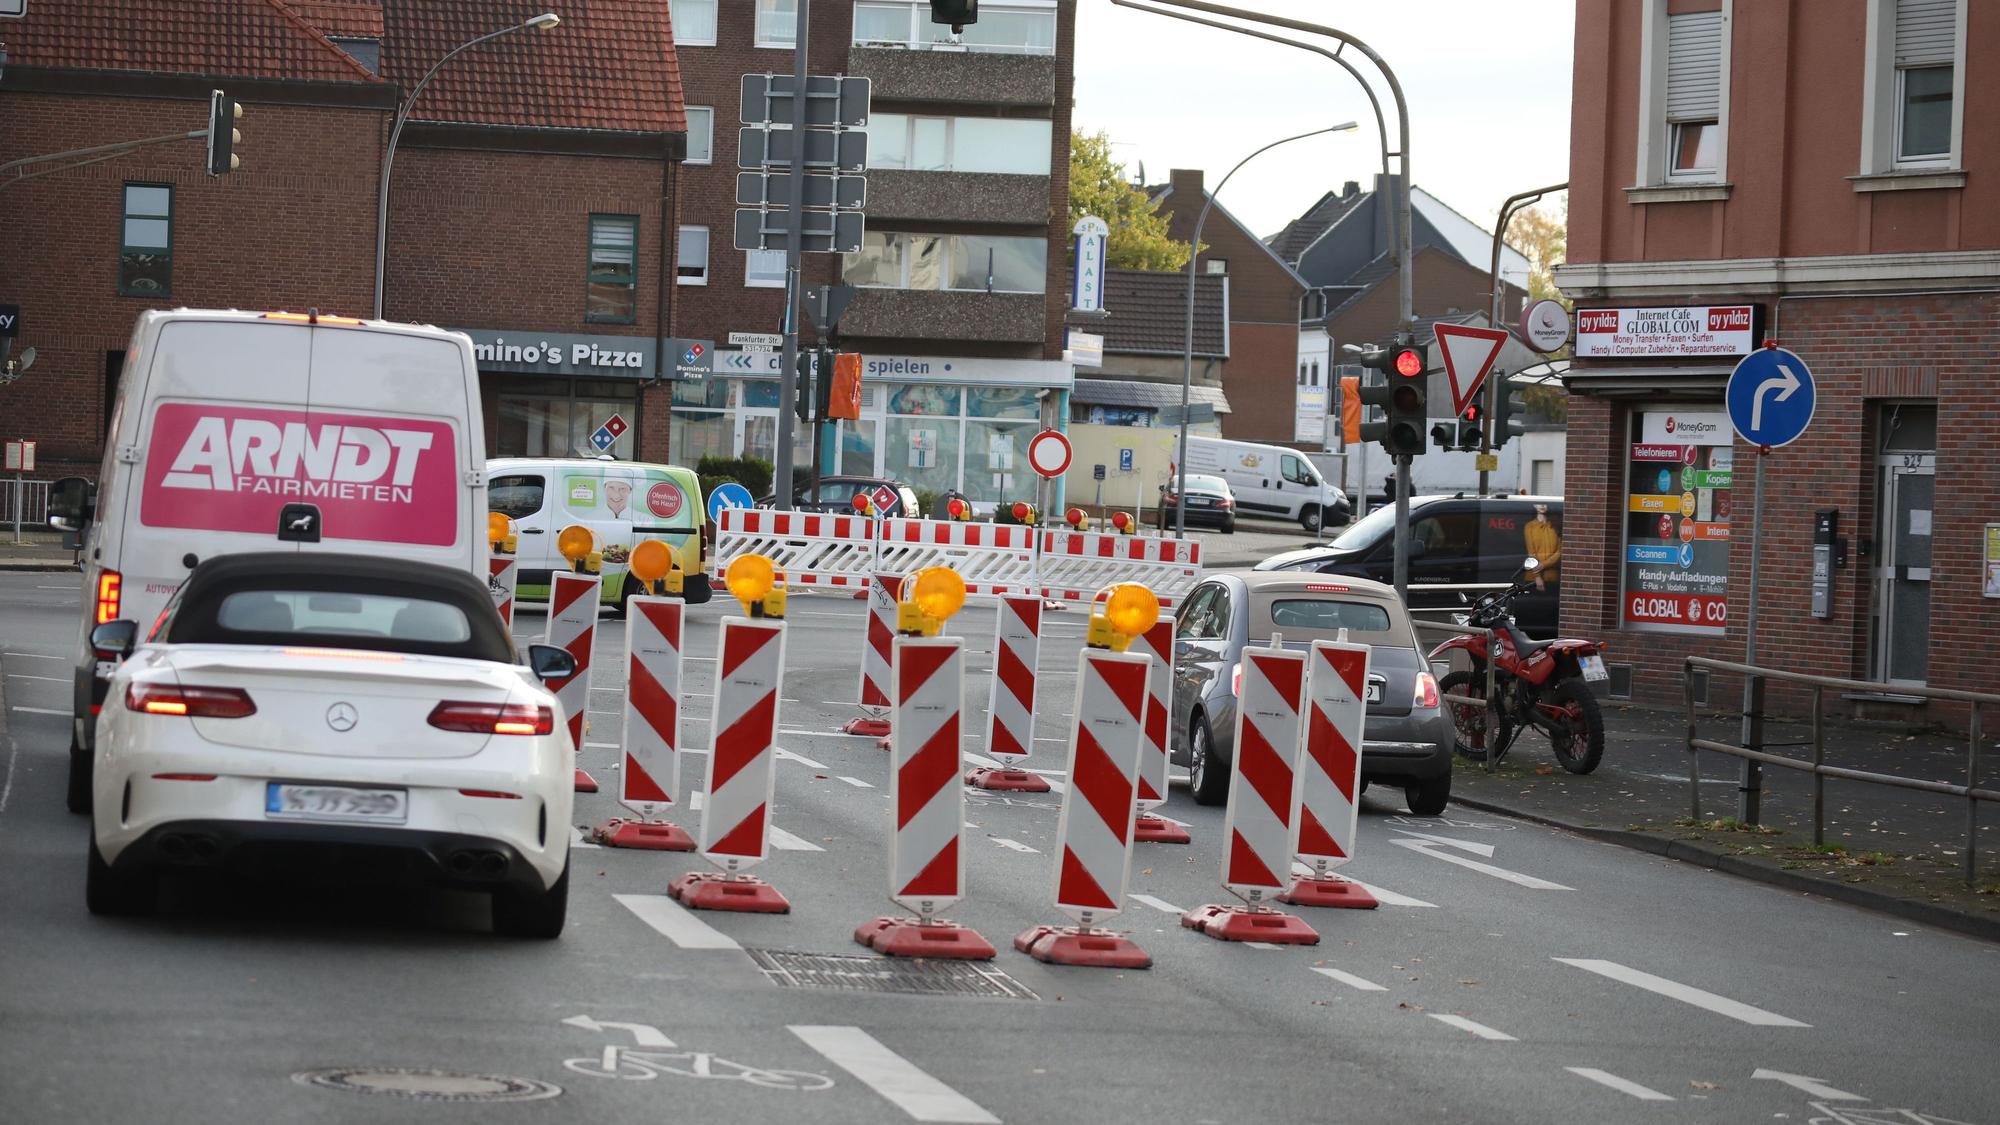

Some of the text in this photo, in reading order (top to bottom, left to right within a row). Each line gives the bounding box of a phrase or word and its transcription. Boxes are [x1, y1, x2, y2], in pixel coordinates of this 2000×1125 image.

[1637, 308, 1691, 320] Internet Cafe
[1626, 320, 1699, 334] GLOBAL COM
[731, 334, 780, 345] Frankfurter Str.
[1613, 333, 1714, 345] Money Transfer Faxen Surfen
[572, 343, 643, 368] Pizza
[1591, 346, 1611, 355] Handy
[1616, 345, 1647, 355] Computer
[1649, 344, 1675, 353] Zubehör
[1681, 344, 1737, 354] Reparaturservice
[676, 364, 711, 373] Domino's
[868, 358, 930, 376] spielen
[1676, 422, 1717, 433] MoneyGram
[161, 416, 434, 492] ARNDT
[1634, 446, 1677, 458] Telefonieren
[237, 475, 413, 504] FAIRMIETEN
[1641, 497, 1664, 508] Faxen
[1488, 518, 1516, 529] AEG
[1635, 548, 1667, 559] Scannen
[1632, 597, 1727, 621] GLOBAL CO
